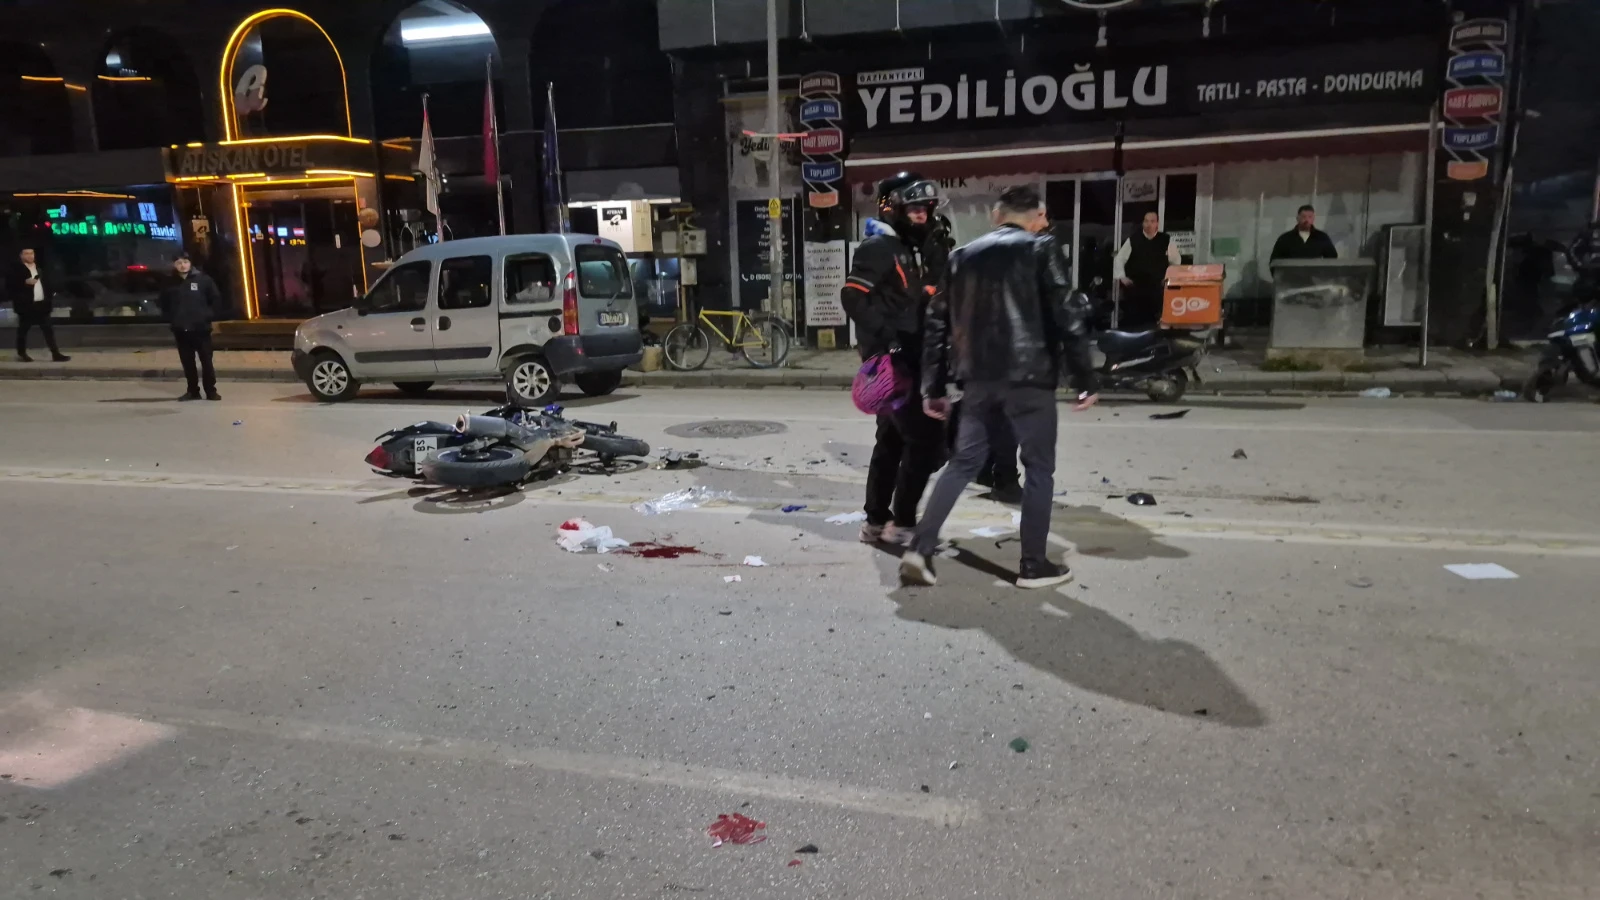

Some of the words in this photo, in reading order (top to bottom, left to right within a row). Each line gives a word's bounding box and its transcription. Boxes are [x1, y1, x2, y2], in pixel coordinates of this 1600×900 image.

[859, 68, 922, 82] GAZİANTEPLİ
[1197, 82, 1240, 102] TATLI
[1256, 78, 1307, 97] PASTA
[1324, 69, 1423, 93] DONDURMA
[857, 63, 1168, 128] YEDİLİOĞLU
[263, 145, 315, 169] OTEL
[1171, 296, 1210, 317] go
